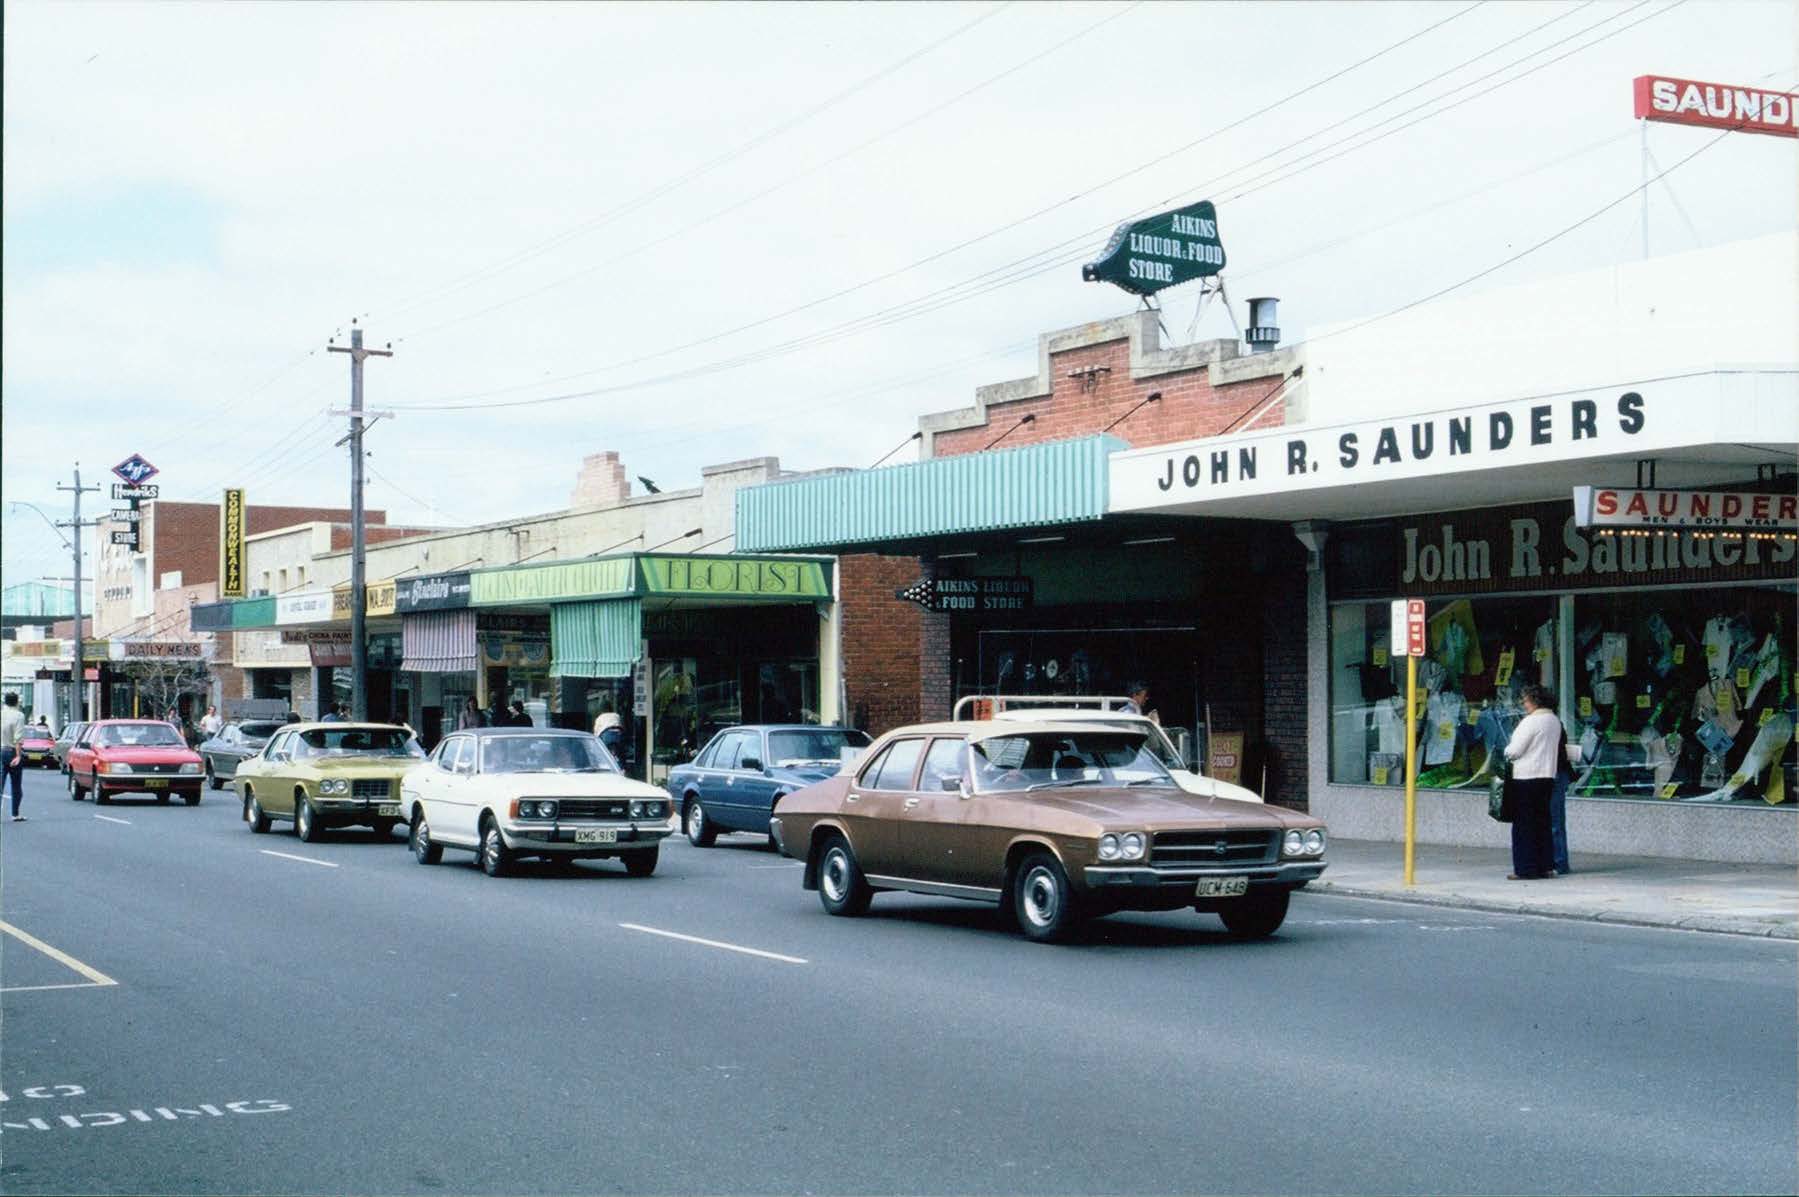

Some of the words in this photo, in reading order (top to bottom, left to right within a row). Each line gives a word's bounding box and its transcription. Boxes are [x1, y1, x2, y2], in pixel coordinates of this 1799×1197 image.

[1653, 80, 1798, 127] SAUND
[1171, 214, 1216, 239] AIKINS
[1130, 233, 1182, 259] LIQUOR
[1188, 241, 1223, 265] FOOD
[1129, 257, 1173, 282] STORE
[1158, 446, 1258, 492] JOHN
[1287, 439, 1319, 475] R.
[1338, 391, 1646, 470] SAUNDERS
[1641, 516, 1668, 524] MEN
[1696, 517, 1729, 525] BOYS
[1744, 518, 1779, 526] WEAR
[228, 491, 239, 590] COMMONWEALTH
[1402, 524, 1492, 583] John
[1509, 517, 1557, 577] R.
[663, 559, 806, 594] FLORIST
[935, 579, 978, 592] AIKINS
[942, 596, 976, 609] FOOD
[983, 597, 1025, 609] STORE
[128, 642, 164, 656] DAILY
[167, 642, 200, 656] NEWS
